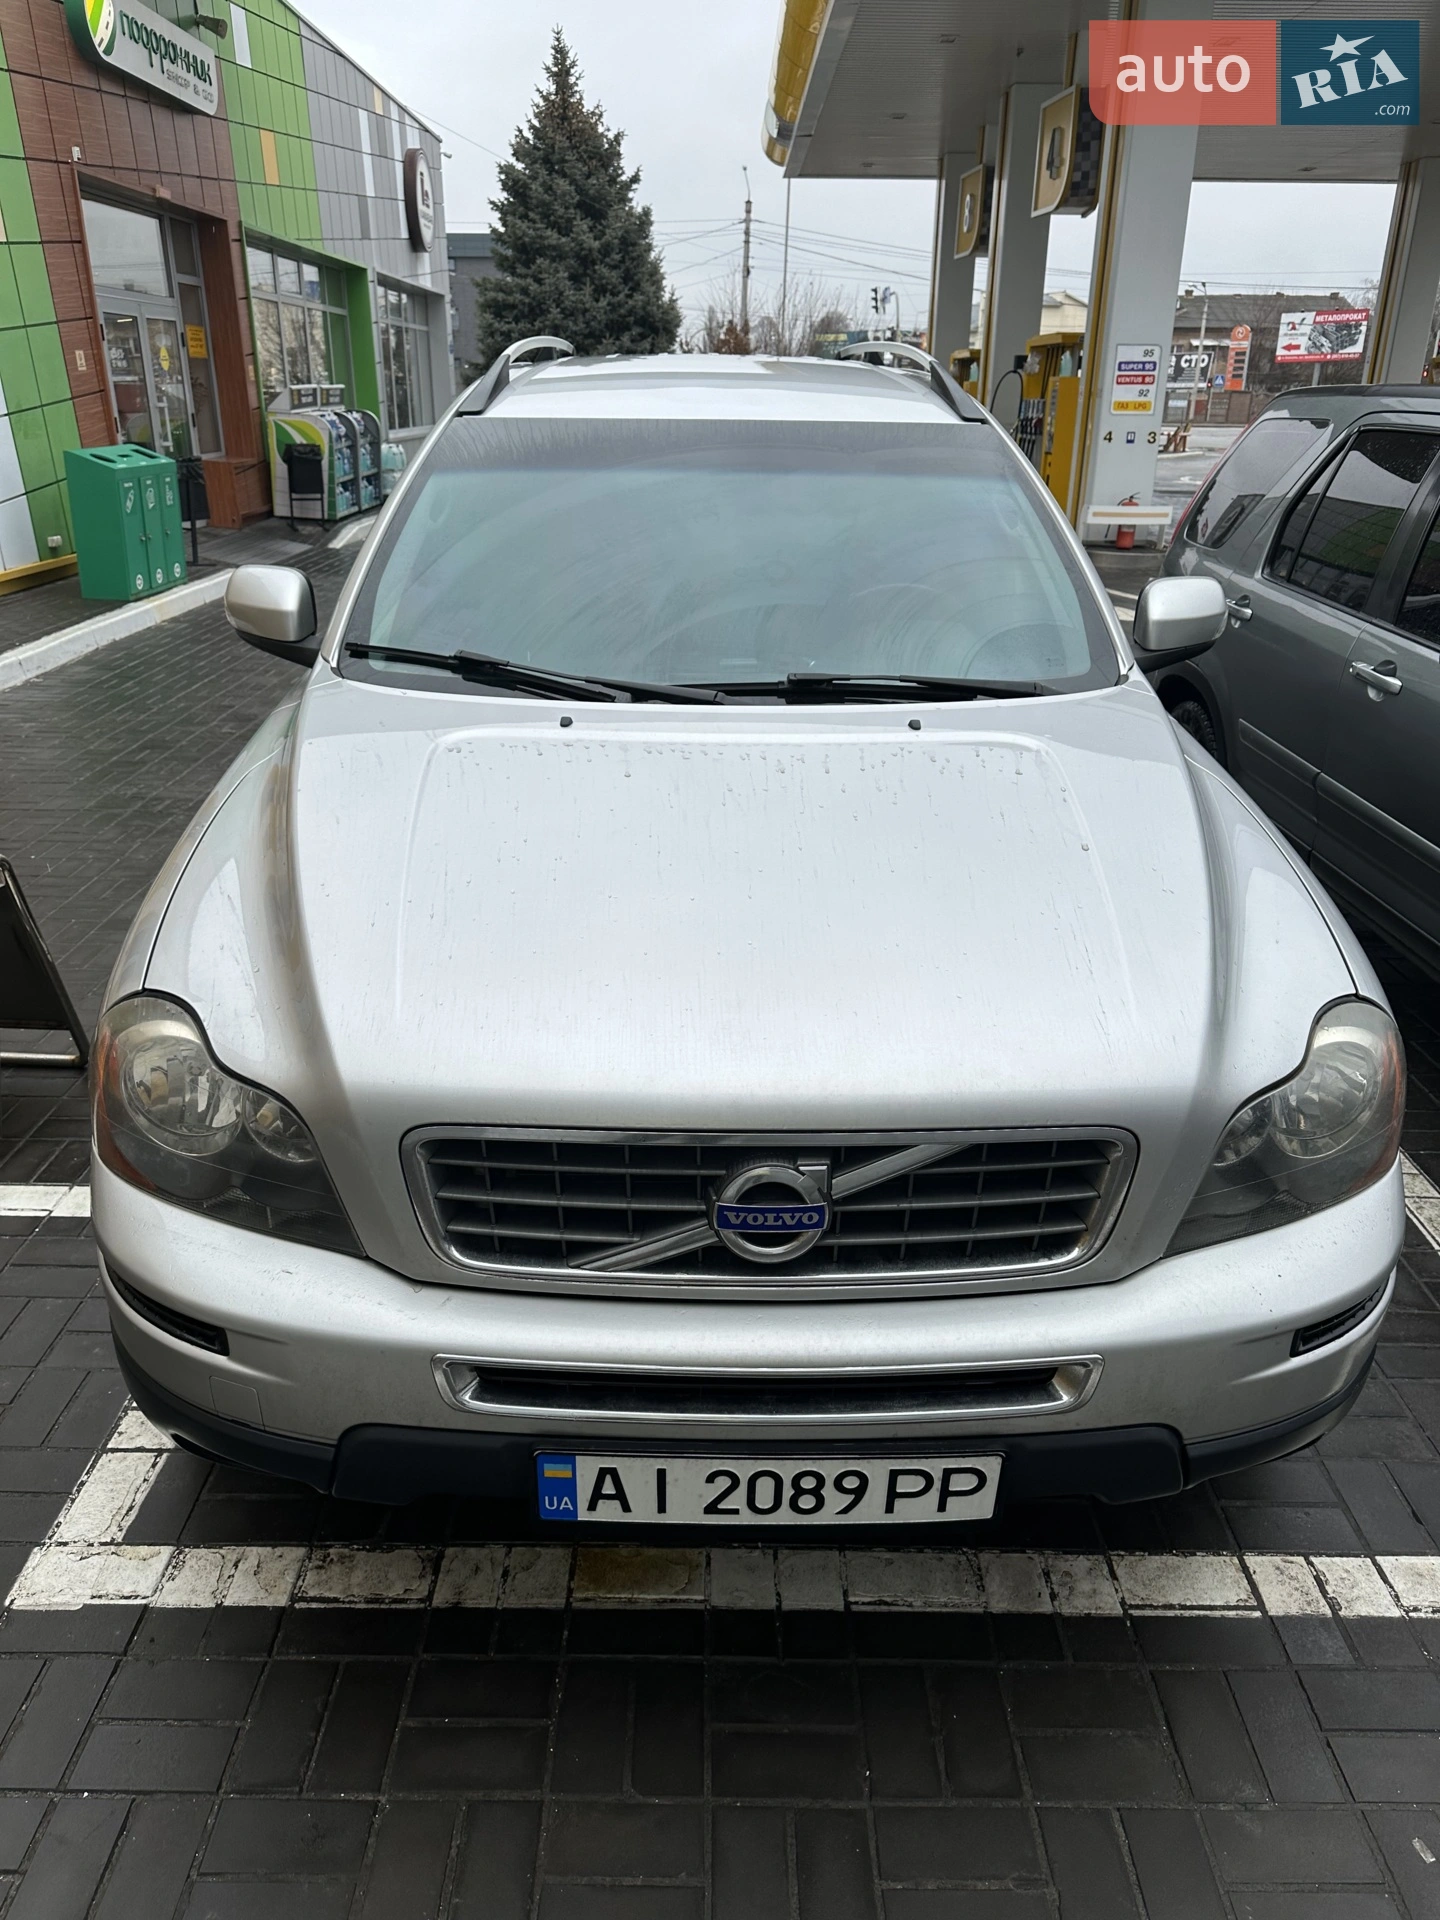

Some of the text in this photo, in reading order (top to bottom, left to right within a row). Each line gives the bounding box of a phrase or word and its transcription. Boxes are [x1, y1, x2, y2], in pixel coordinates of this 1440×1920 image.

[1046, 126, 1062, 180] 4
[963, 193, 973, 234] 8
[1315, 312, 1366, 322] МЕТАЛОПРОКАТ
[1143, 349, 1155, 357] 95
[1180, 354, 1209, 368] СТО
[1117, 376, 1142, 384] VENTUS
[1138, 389, 1150, 397] 92
[1103, 431, 1113, 443] 4
[1147, 431, 1157, 444] 3
[723, 1210, 819, 1226] VOLVO
[703, 1469, 870, 1516] 2089
[884, 1467, 988, 1514] PP
[545, 1496, 574, 1512] UA
